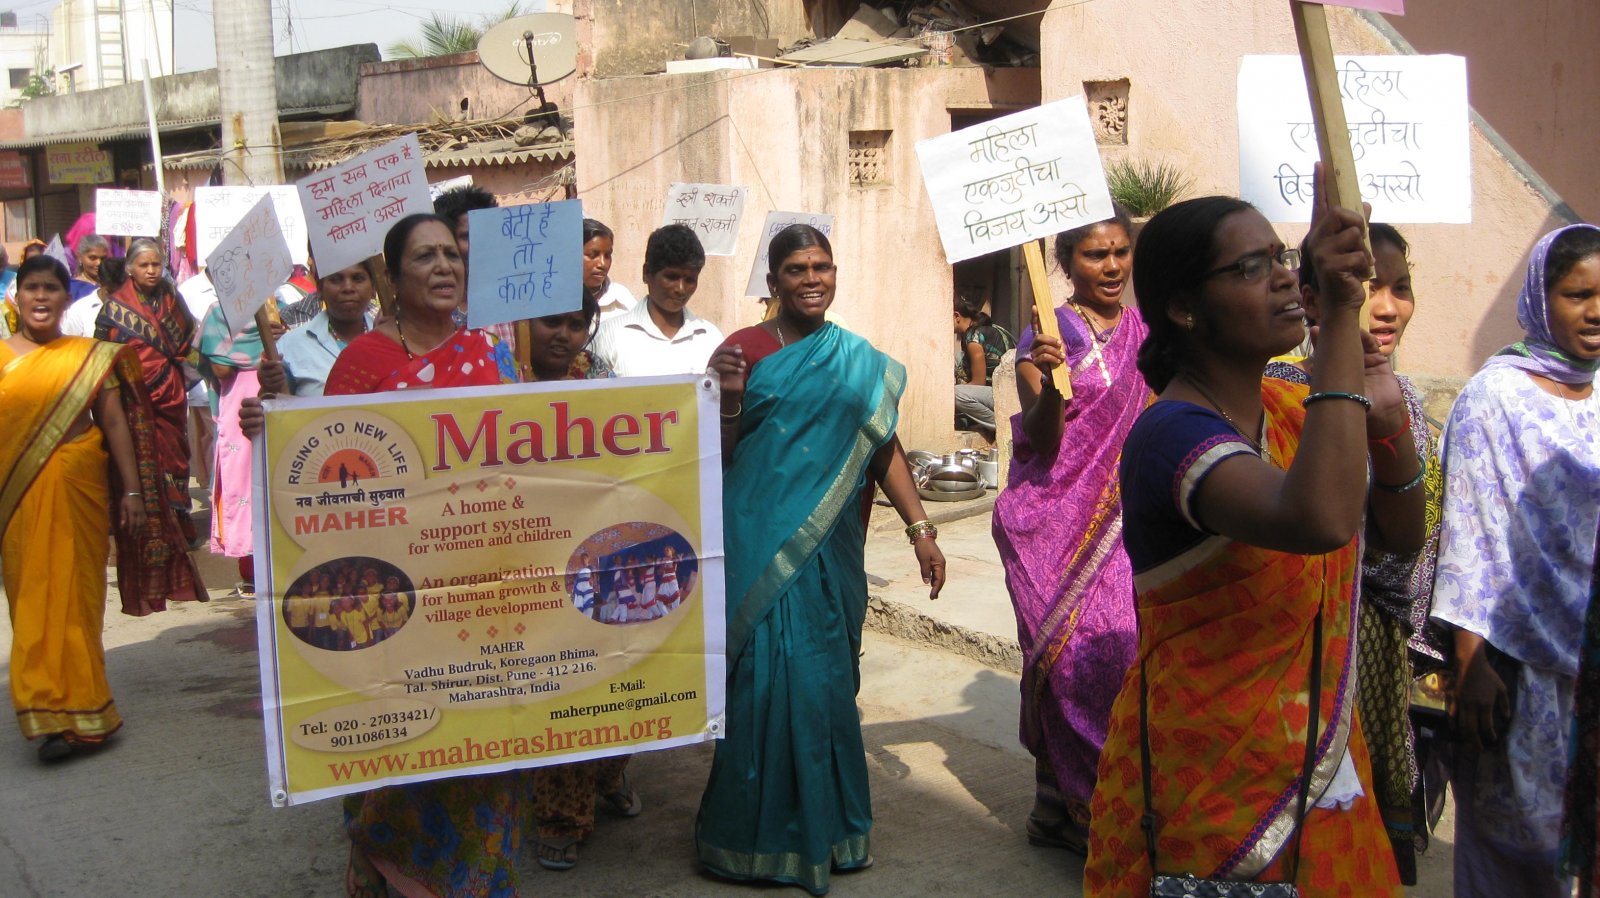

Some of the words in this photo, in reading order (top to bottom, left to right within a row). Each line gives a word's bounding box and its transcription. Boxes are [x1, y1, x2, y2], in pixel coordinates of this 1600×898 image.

[968, 123, 1038, 163] महिला
[1287, 110, 1423, 161] एजुटीचा
[306, 176, 336, 200] हम
[340, 164, 367, 184] सब
[373, 153, 399, 171] एक
[963, 157, 1062, 205] एकजुटीचा
[316, 191, 364, 221] महिला
[367, 170, 412, 198] दिनाचा
[326, 216, 367, 243] विजय
[373, 196, 408, 223] असो
[501, 204, 534, 240] बेटी
[538, 203, 555, 238] है
[964, 210, 1026, 244] विजय
[512, 239, 542, 269] तो
[498, 271, 536, 304] कल
[542, 255, 558, 299] है
[430, 401, 678, 471] Maher
[288, 436, 320, 484] RISING
[324, 422, 345, 437] TO
[354, 421, 388, 441] NEW
[387, 443, 408, 475] LIFE
[295, 496, 312, 507] नव
[316, 488, 365, 506] जीवनाची
[369, 488, 405, 506] सुरुवात
[441, 502, 455, 516] A
[460, 499, 507, 515] home
[512, 495, 525, 509] &
[294, 506, 409, 535] MAHER
[420, 521, 487, 541] support
[492, 516, 552, 534] system
[408, 542, 430, 555] for
[434, 538, 484, 552] women
[488, 533, 512, 546] and
[516, 528, 572, 544] children
[419, 576, 444, 590] An
[450, 564, 556, 587] organization
[422, 594, 443, 607] for
[447, 590, 495, 605] human
[499, 582, 547, 601] growth
[550, 580, 561, 592] &
[425, 608, 471, 624] village
[475, 598, 564, 618] development
[479, 640, 525, 656] MAHER
[404, 666, 444, 680] Vadhu
[448, 659, 496, 674] Budruk,
[500, 654, 556, 668] Koregaon
[560, 649, 599, 662] Bhima,
[404, 681, 427, 694] Tal.
[476, 673, 503, 686] Dist.
[506, 669, 536, 682] Pune
[546, 664, 568, 677] 412
[573, 661, 597, 674] 216.
[449, 686, 527, 703] Maharashtra,
[530, 680, 560, 694] India
[609, 679, 646, 694] E-Mail:
[299, 722, 328, 735] Tel:
[334, 719, 358, 732] 020
[369, 707, 436, 727] 27033421/
[550, 690, 697, 721] maherpune@gmail.com
[327, 715, 673, 781] www.maherashram.org
[330, 727, 408, 748] 9011086134
